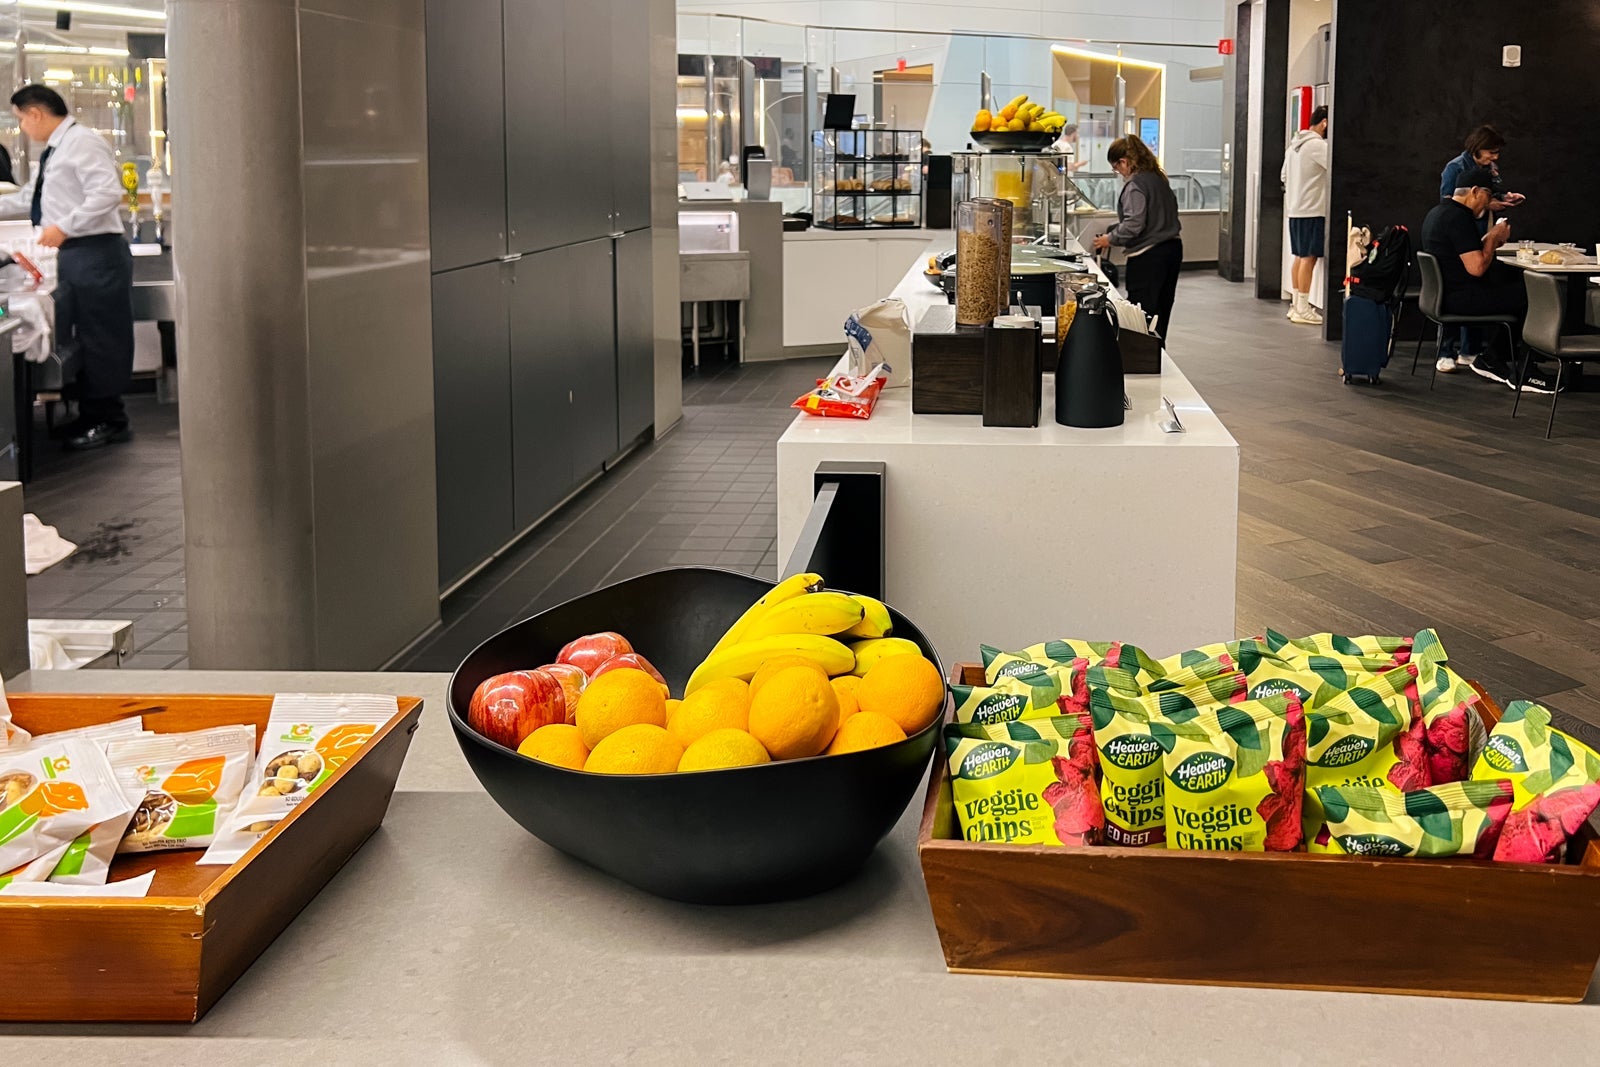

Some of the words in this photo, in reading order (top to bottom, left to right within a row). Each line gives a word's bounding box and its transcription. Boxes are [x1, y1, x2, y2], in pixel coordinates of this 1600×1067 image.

[1528, 377, 1546, 387] HOKA
[1255, 685, 1302, 699] Hean
[976, 696, 1020, 720] Heaven
[987, 706, 1021, 726] EARTH
[964, 746, 1011, 771] Heaven
[1109, 741, 1159, 754] Heaven
[1325, 739, 1368, 760] Heaven
[1329, 750, 1366, 766] EARTH
[1488, 735, 1522, 765] Heaven
[973, 758, 1011, 778] EARTH
[1117, 752, 1157, 767] EARTH
[1177, 757, 1227, 780] Heaven
[1187, 768, 1227, 790] EARTH
[1110, 777, 1165, 806] eggi
[965, 788, 1039, 820] Veggie
[966, 816, 1033, 842] Chips
[1172, 803, 1253, 834] Veggie
[1106, 823, 1121, 842] ED
[1123, 831, 1150, 845] BEET
